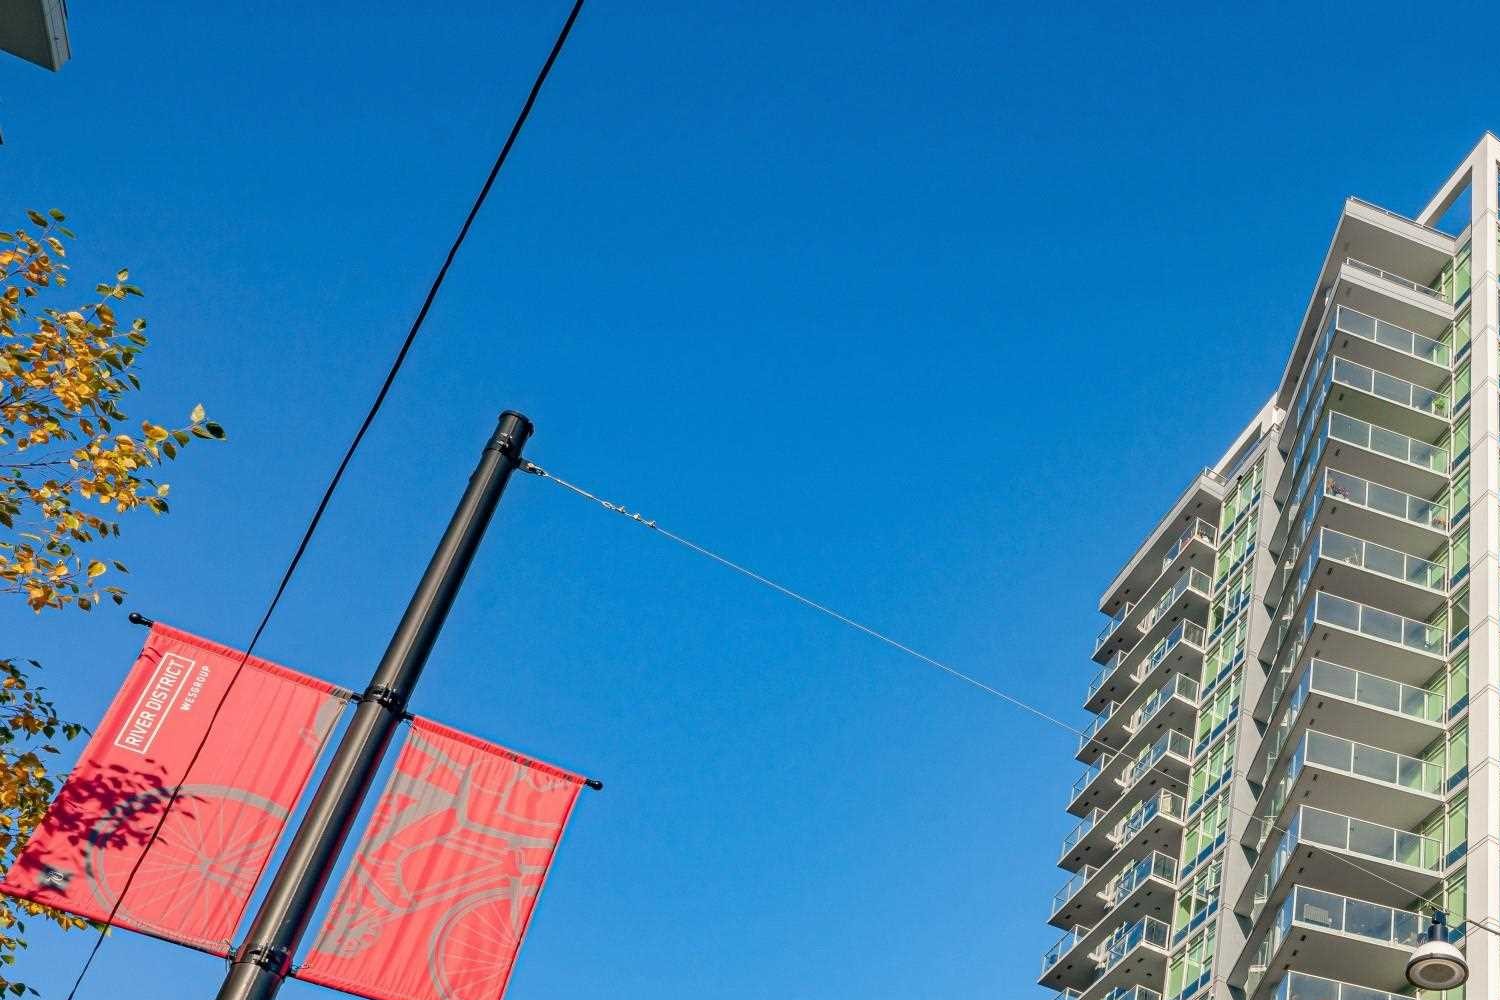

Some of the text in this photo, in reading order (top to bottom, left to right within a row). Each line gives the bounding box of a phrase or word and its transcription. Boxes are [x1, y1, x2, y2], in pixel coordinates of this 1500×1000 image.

[125, 659, 185, 746] RIVER DISTRICT
[180, 665, 211, 711] WESGROUP
